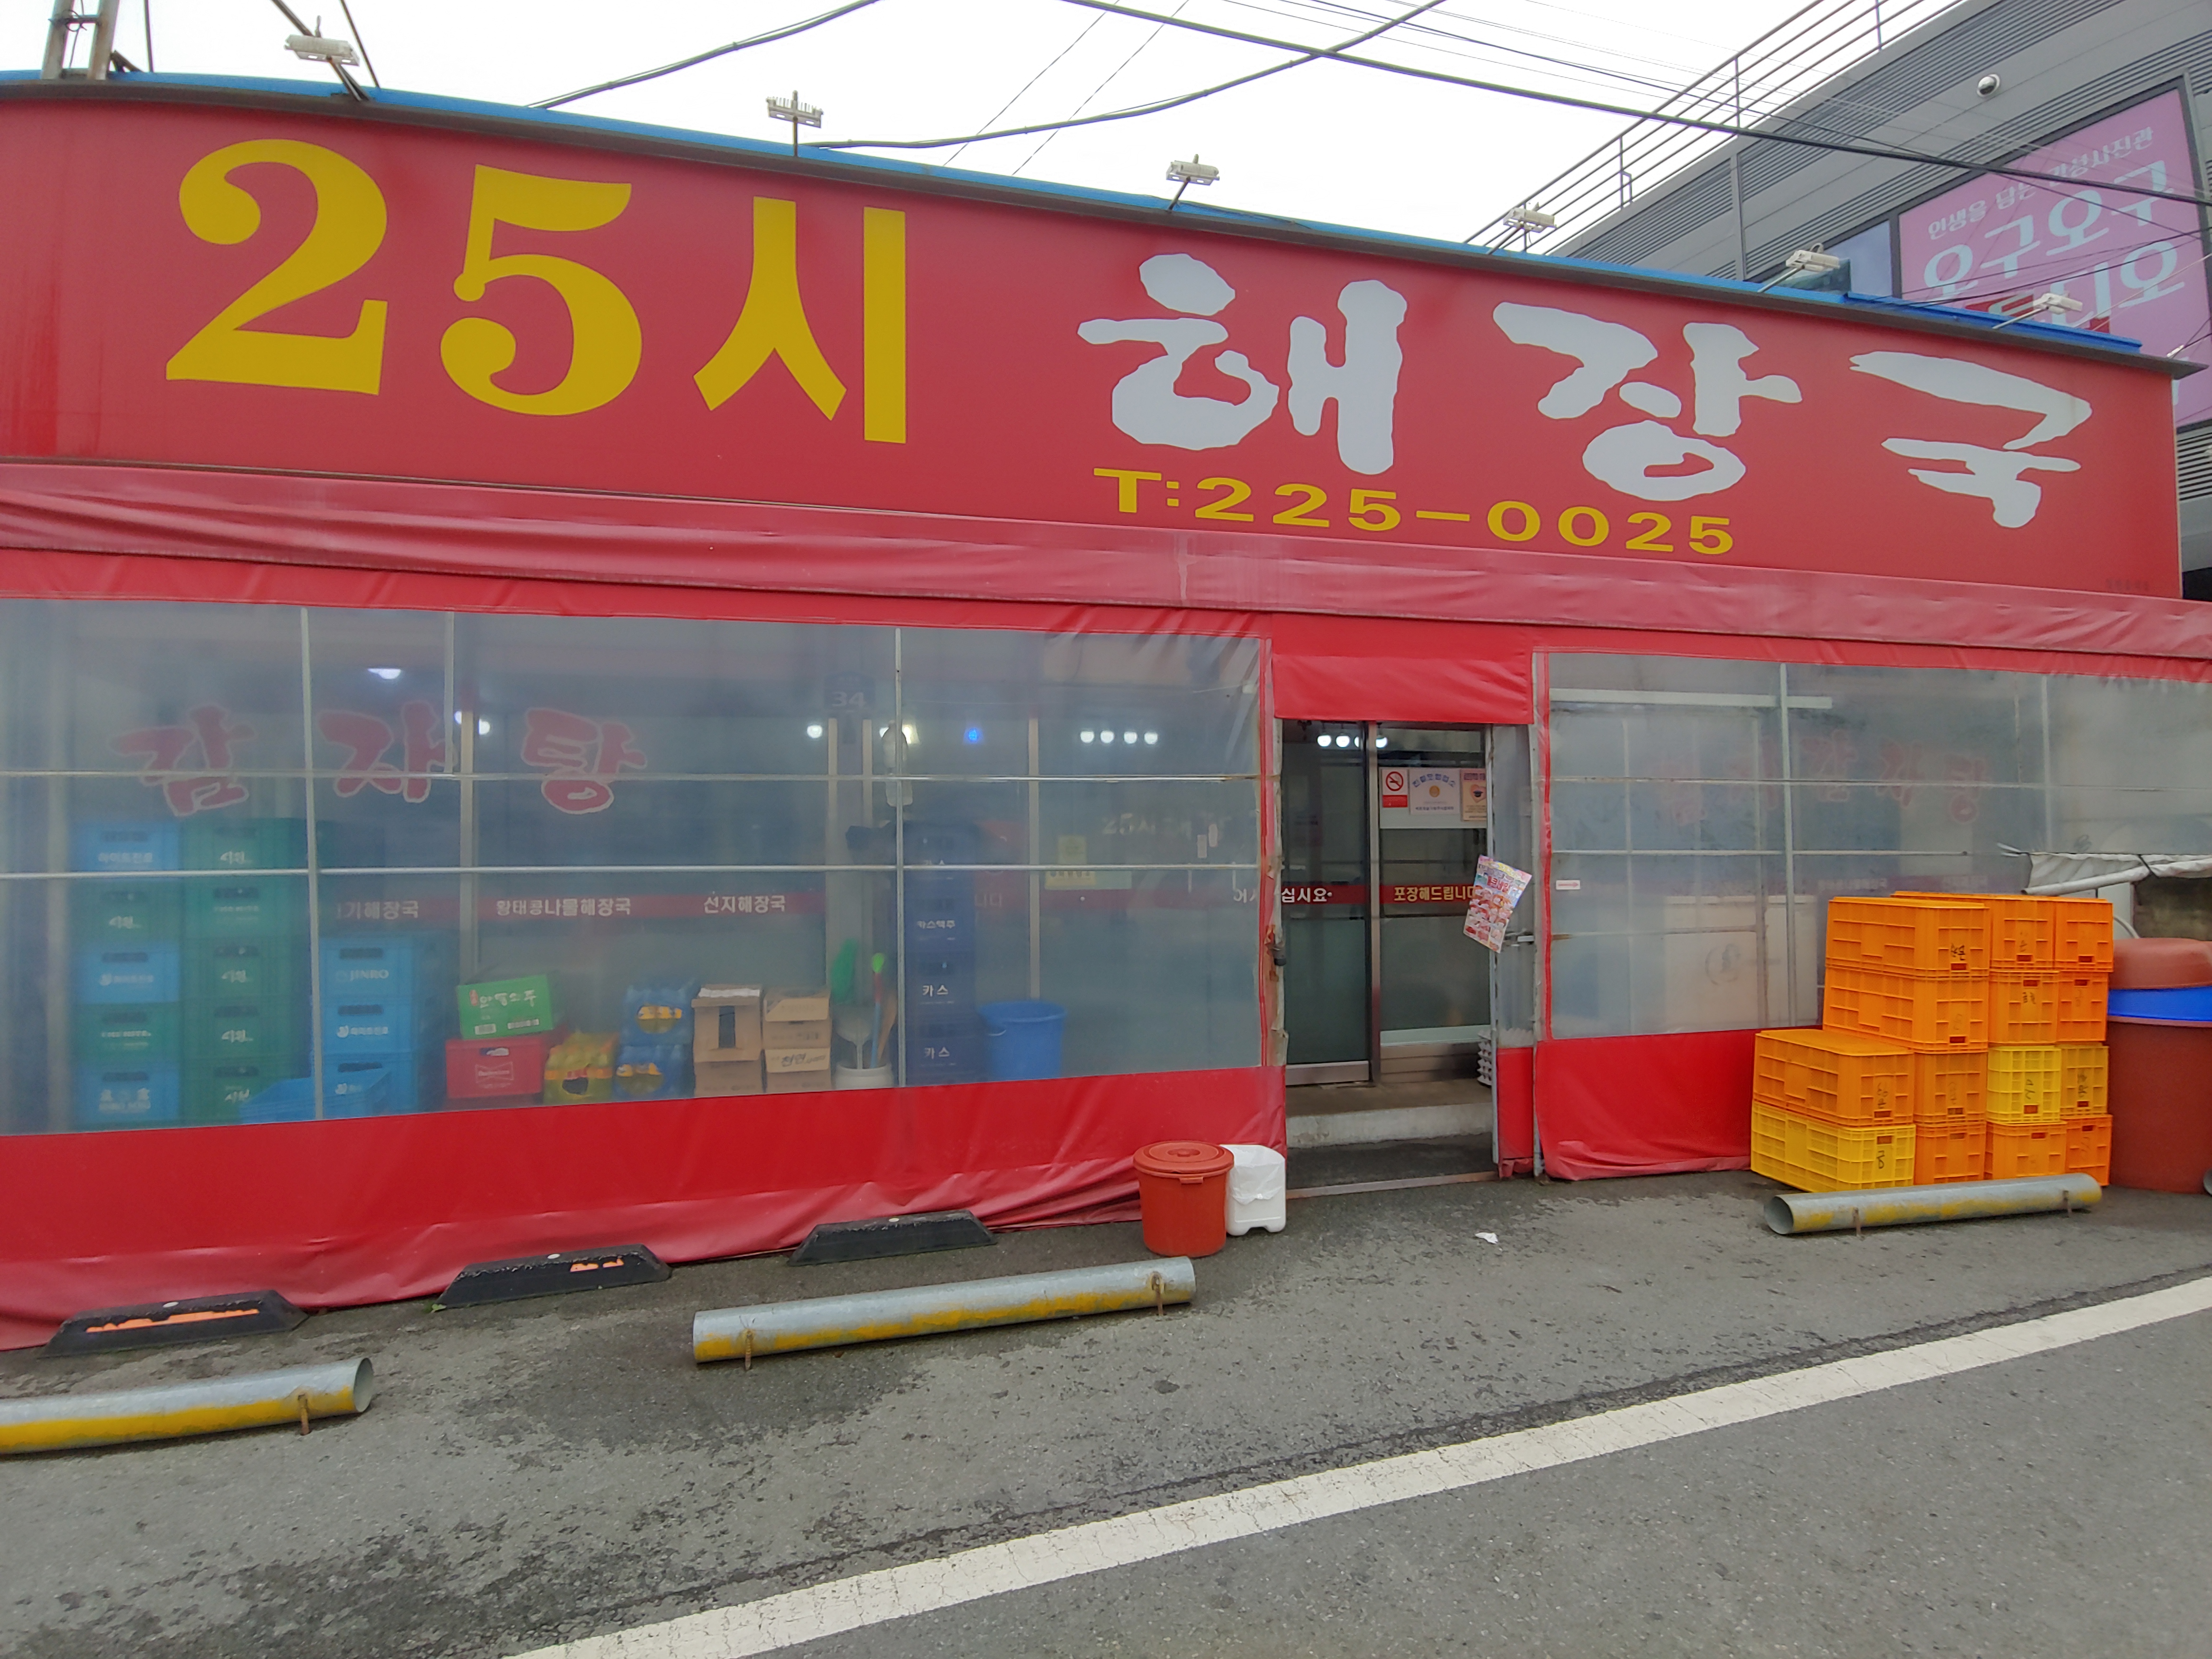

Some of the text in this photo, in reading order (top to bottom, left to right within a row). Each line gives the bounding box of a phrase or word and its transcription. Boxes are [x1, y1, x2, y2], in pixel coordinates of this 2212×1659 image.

[1923, 160, 2174, 305] 오구오구
[167, 140, 2091, 527] 25시 해장국
[704, 894, 786, 914] 선지해장국
[350, 969, 390, 981] JINRO
[922, 984, 949, 998] 카스
[924, 1047, 950, 1060] 카스
